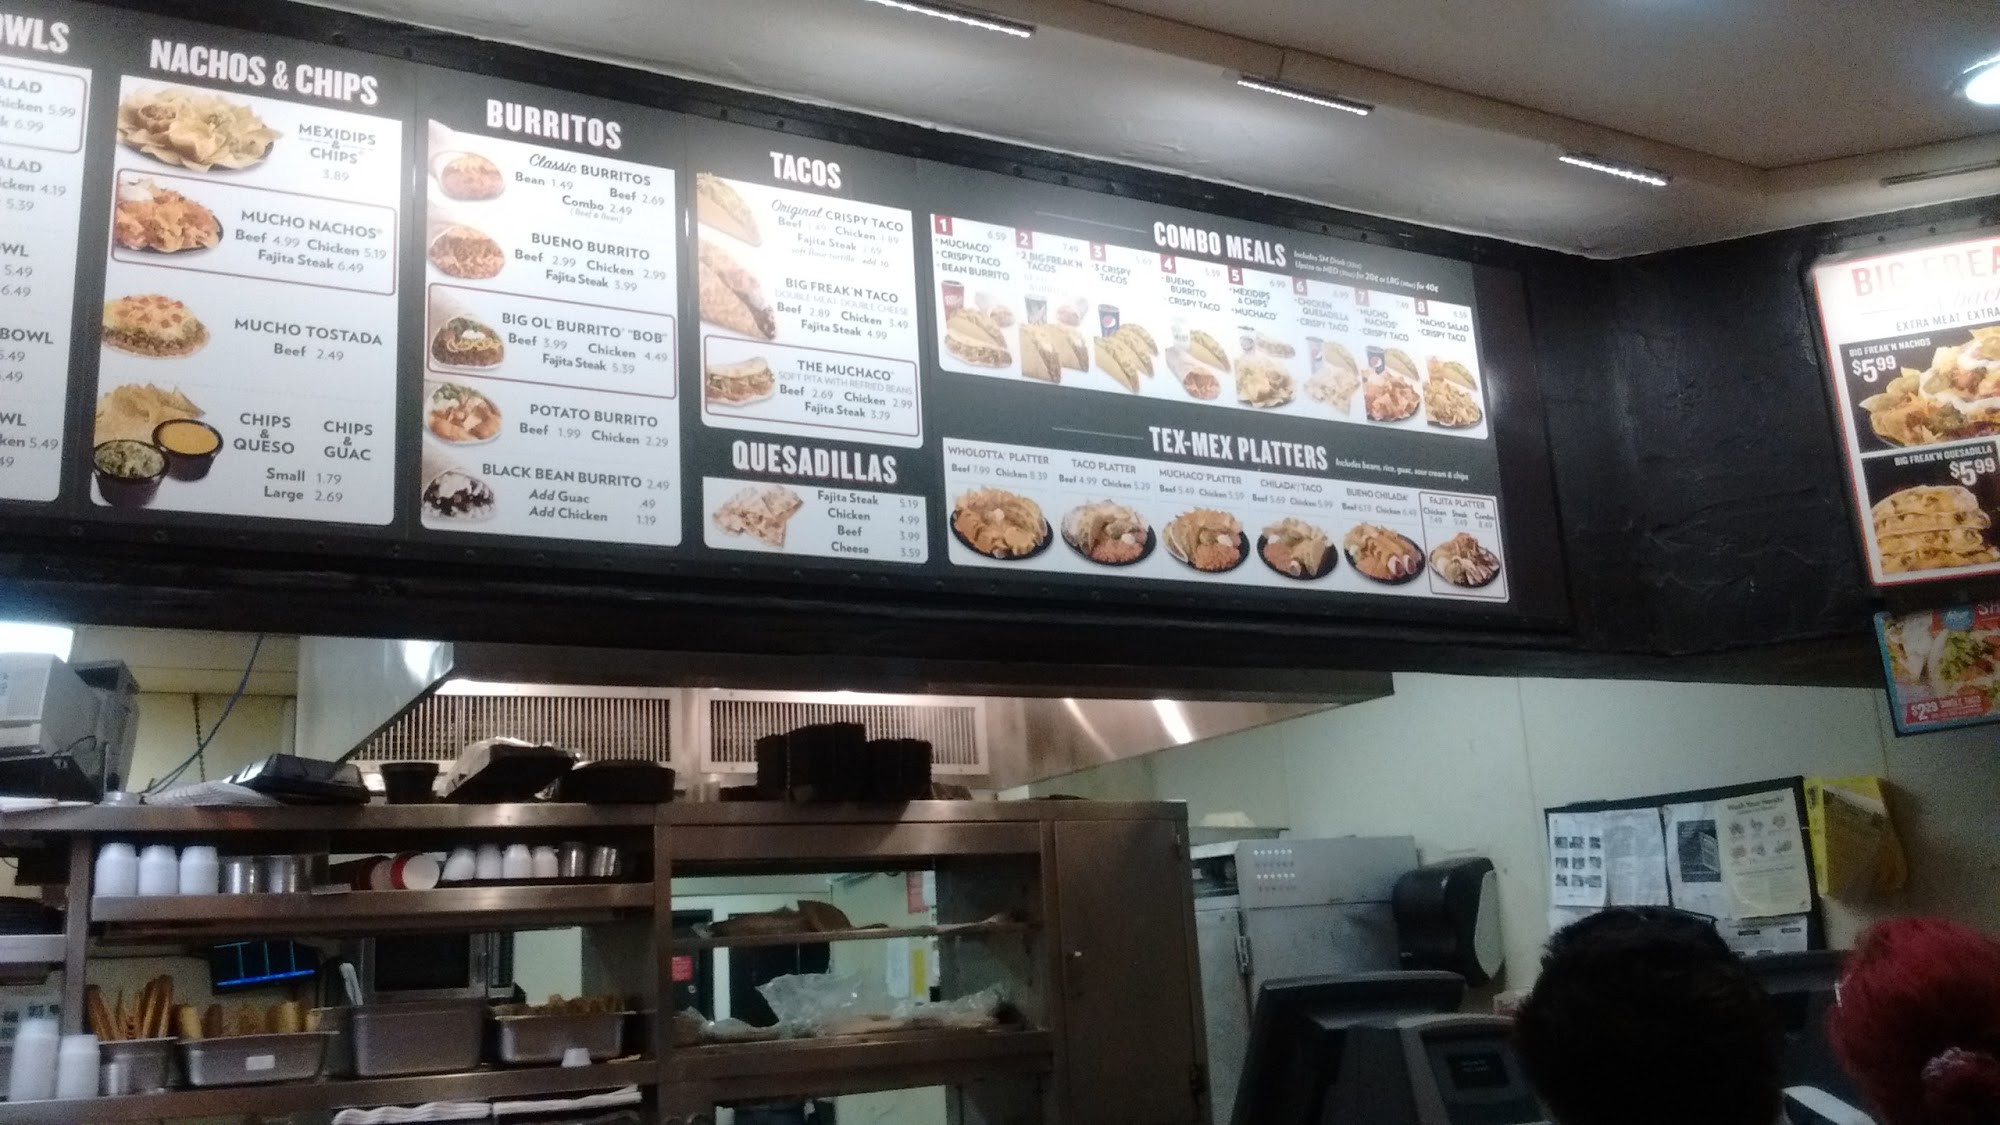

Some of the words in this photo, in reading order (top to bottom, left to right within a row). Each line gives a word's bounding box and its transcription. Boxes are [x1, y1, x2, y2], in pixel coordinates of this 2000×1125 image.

[150, 39, 265, 86] NACHOS
[272, 61, 289, 90] &
[296, 64, 378, 105] CHIPS
[487, 99, 622, 150] BURRITOS
[299, 124, 376, 145] MEXIDIPS
[332, 140, 341, 149] &
[310, 148, 358, 164] CHIPS
[529, 153, 577, 173] Classic
[581, 164, 651, 186] BURRITOS
[770, 151, 842, 189] TACOS
[515, 172, 545, 186] Bean
[552, 178, 574, 190] 1.49
[610, 188, 636, 201] Beef
[562, 195, 604, 211] Combo
[771, 199, 823, 220] Original
[826, 210, 868, 225] CRISPY
[871, 218, 903, 232] TACO
[241, 211, 305, 228] MUCHO
[309, 220, 377, 238] NACHOS
[940, 219, 947, 233] 1
[835, 226, 876, 241] Chicken
[1020, 233, 1029, 245] 2
[236, 229, 267, 243] Beef
[273, 236, 300, 248] 4.99
[307, 239, 359, 256] Chicken
[364, 248, 386, 259] 5.19
[532, 233, 583, 250] BUENO
[588, 242, 650, 260] BURRITO
[798, 233, 826, 246] Fajita
[829, 239, 857, 251] Steak
[940, 238, 989, 253] MUCHACO
[1154, 221, 1221, 256] COMBO
[1226, 235, 1286, 267] MEALS
[941, 251, 974, 263] CRISPY
[976, 256, 1000, 267] TACO
[1029, 253, 1044, 262] BIG
[1094, 246, 1102, 258] 3
[258, 250, 294, 265] Fajita
[298, 255, 333, 269] Steak
[338, 262, 364, 273] 6.49
[515, 249, 544, 262] Beef
[553, 256, 576, 267] 2.99
[587, 260, 634, 276] Chicken
[1027, 262, 1056, 274] TACOS
[1163, 259, 1172, 270] 4
[546, 270, 576, 285] Fajita
[578, 274, 608, 288] Steak
[942, 263, 967, 274] BEAN
[969, 266, 1010, 281] BURRITO
[1100, 273, 1128, 285] TACOS
[1102, 265, 1131, 277] CRISPY
[1232, 270, 1240, 282] 5
[1165, 276, 1195, 287] BUENO
[1296, 281, 1304, 292] 6
[786, 278, 807, 290] BIG
[866, 289, 898, 303] TACO
[1171, 286, 1207, 298] BURRITO
[1358, 292, 1366, 302] 7
[1168, 297, 1197, 308] CRISPY
[1199, 302, 1220, 312] TACO
[1244, 298, 1268, 308] CHIPS
[1418, 301, 1426, 312] 8
[777, 302, 802, 314] Beef
[841, 311, 882, 326] Chicken
[1235, 308, 1276, 320] MUCHACO
[1896, 316, 1929, 332] EXTRA
[1933, 312, 1960, 325] MEAT
[234, 318, 301, 336] MUCHO
[306, 326, 383, 345] TOSTADA
[502, 313, 527, 326] BIG
[556, 320, 621, 338] BURRITO
[801, 320, 830, 333] Fajita
[832, 323, 861, 337] Steak
[1328, 322, 1348, 332] TACO
[1419, 319, 1446, 328] NACHO
[1447, 322, 1469, 332] SALAD
[1389, 332, 1409, 342] TACO
[1448, 333, 1466, 342] TACO
[274, 343, 306, 358] Beef
[316, 349, 344, 362] 2.49
[508, 333, 537, 346] Beef
[544, 339, 567, 350] 3.99
[588, 343, 636, 359] Chicken
[645, 352, 668, 362] 4.49
[1850, 348, 1863, 357] BIG
[1899, 338, 1931, 350] NACHOS
[543, 354, 573, 368] Fajita
[576, 358, 606, 371] Steak
[797, 360, 822, 372] THE
[826, 364, 891, 381] MUCHACO
[780, 385, 804, 396] Beef
[812, 390, 833, 399] 2.69
[844, 392, 886, 406] Chicken
[530, 404, 590, 420] POTATO
[594, 411, 658, 427] BURRITO
[805, 402, 834, 415] Fajita
[837, 405, 866, 418] Steak
[240, 412, 291, 429] CHIPS
[323, 420, 373, 436] CHIPS
[260, 428, 269, 439] &
[343, 436, 352, 446] &
[520, 422, 549, 435] Beef
[558, 428, 580, 439] 1.99
[591, 430, 640, 445] Chicken
[30, 437, 58, 450] 5.49
[233, 437, 295, 454] QUESO
[1149, 426, 1233, 461] TEX-MEX
[1238, 437, 1328, 471] PLATTERS
[324, 446, 371, 461] GUAC
[948, 446, 1004, 460] WHOLOTTA
[1009, 453, 1049, 464] PLATTER
[1894, 457, 1909, 466] BIG
[1944, 445, 1993, 459] QUESADILLA
[732, 440, 897, 484] QUESADILLAS
[1072, 459, 1096, 469] TACO
[1099, 462, 1136, 474] PLATTER
[266, 468, 305, 482] Small
[316, 473, 342, 485] 1.79
[483, 463, 531, 478] BLACK
[535, 468, 574, 482] BEAN
[578, 472, 641, 488] BURRITO
[952, 464, 971, 473] Beef
[996, 468, 1028, 479] Chicken
[1159, 470, 1203, 481] MUCHACO
[1207, 473, 1241, 484] PLATTER
[1059, 474, 1077, 484] Beef
[1102, 479, 1131, 489] Chicken
[1302, 483, 1322, 493] TACO
[264, 486, 304, 503] Large
[314, 491, 343, 503] 2.69
[529, 489, 555, 501] Add
[558, 491, 589, 504] Guac
[817, 490, 847, 504] Fajita
[849, 493, 879, 505] Steak
[1159, 485, 1176, 493] Beef
[1200, 488, 1227, 498] Chicken
[1455, 499, 1485, 509] PLATTER
[529, 506, 555, 518] Add
[558, 508, 608, 522] Chicken
[637, 515, 656, 525] 1.19
[828, 508, 870, 521] Chicken
[900, 516, 920, 524] 4.99
[837, 525, 862, 536] Beef
[831, 542, 869, 554] Cheese
